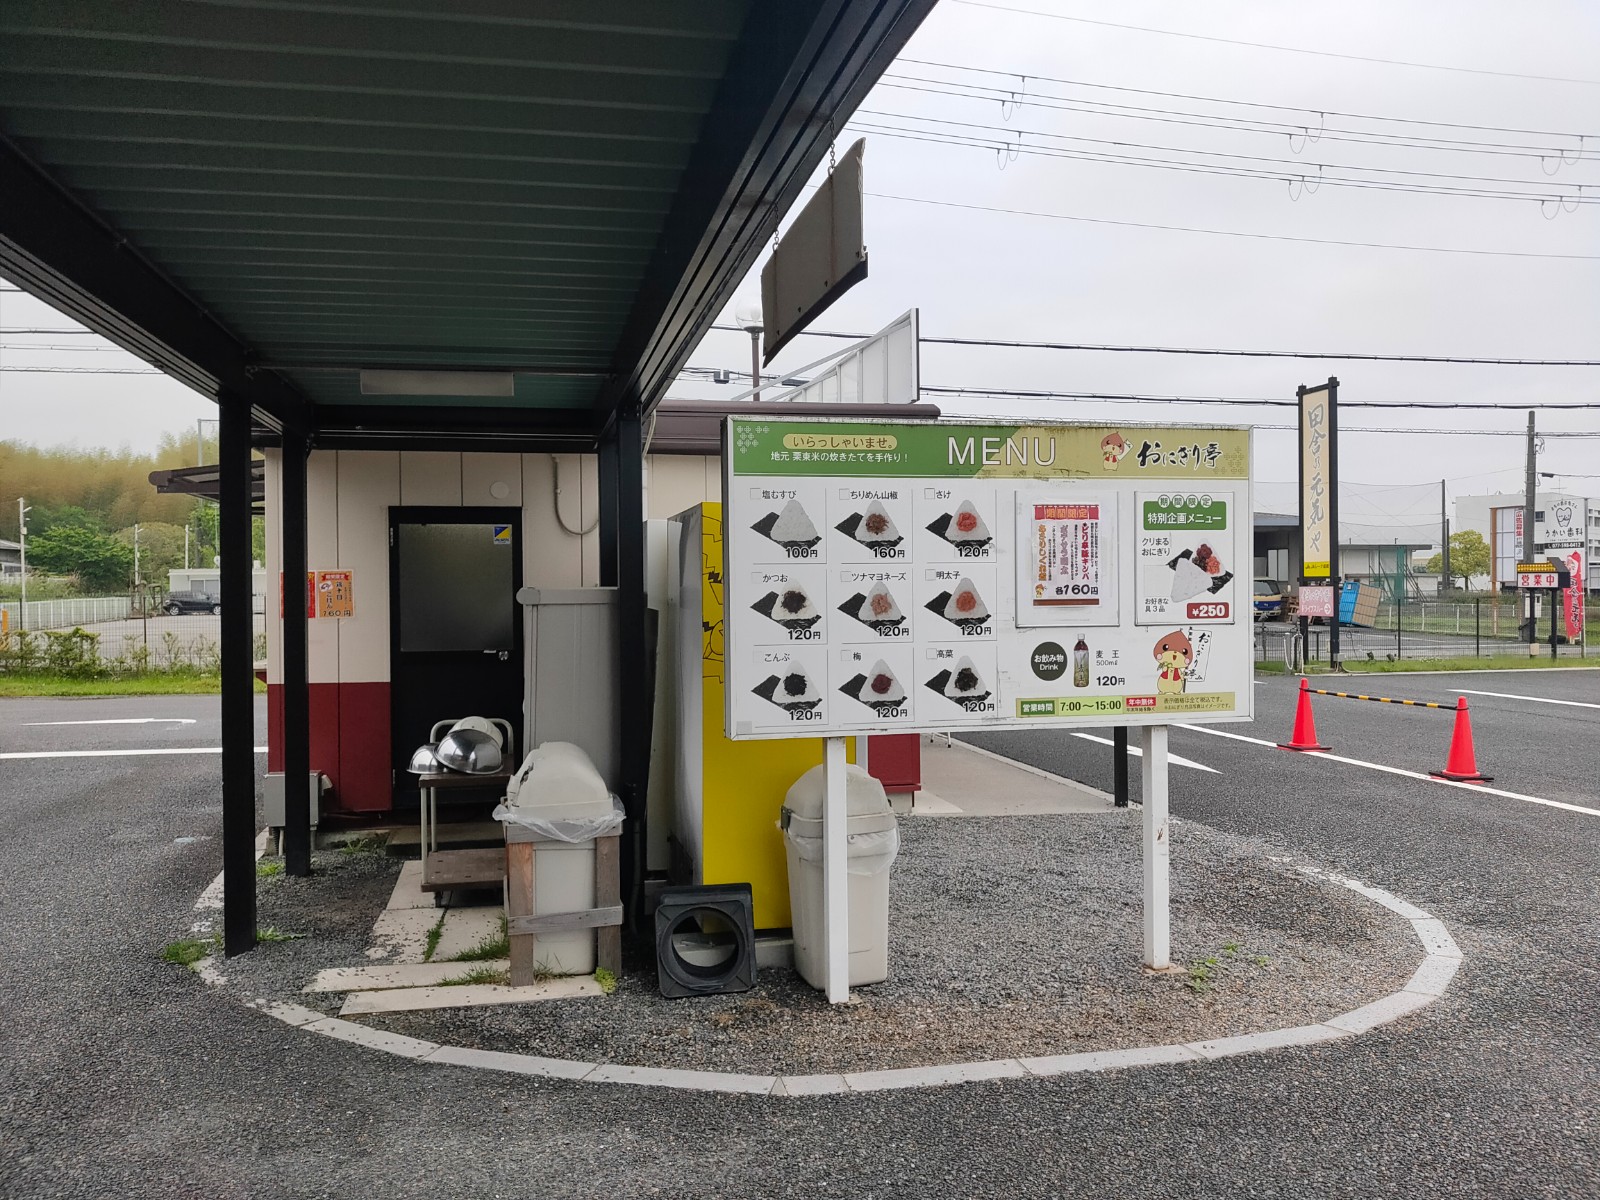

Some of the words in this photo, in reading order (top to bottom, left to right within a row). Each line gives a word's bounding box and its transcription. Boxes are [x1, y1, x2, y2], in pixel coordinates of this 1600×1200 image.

[793, 436, 893, 449] いらっしゃいませ。
[770, 451, 790, 461] 地元
[947, 436, 1056, 466] MENU
[1136, 440, 1223, 469] おにぎり亭
[762, 490, 797, 500] 塩むすび
[850, 490, 898, 500] ちりめん山椒
[935, 490, 951, 499] さけ
[1159, 496, 1211, 507] 期間限定
[1147, 513, 1222, 524] 特別企画メニュー
[1546, 527, 1583, 537] うかい歯科
[785, 547, 818, 559] 100円
[872, 547, 905, 559] 160円
[957, 546, 989, 558] 120円
[1141, 548, 1170, 556] おにぎり
[762, 573, 788, 583] かつお
[851, 572, 907, 582] ツナマヨネーズ
[936, 570, 961, 580] 明太子
[1522, 574, 1555, 586] 営業中
[1192, 604, 1225, 617] ¥250
[787, 629, 821, 641] 120円
[877, 626, 910, 637] 120円
[960, 625, 992, 636] 120円
[764, 653, 790, 662] こんぶ
[853, 652, 862, 661] 梅
[936, 649, 954, 659] 高菜
[1034, 654, 1065, 663] お飲み物
[1039, 663, 1059, 671] Drink
[1096, 676, 1126, 686] 120円
[1128, 698, 1154, 706] 年中無休
[875, 707, 908, 718] 120円
[963, 702, 995, 713] 120円
[1022, 703, 1054, 713] 営業時間
[788, 710, 822, 721] 120円
